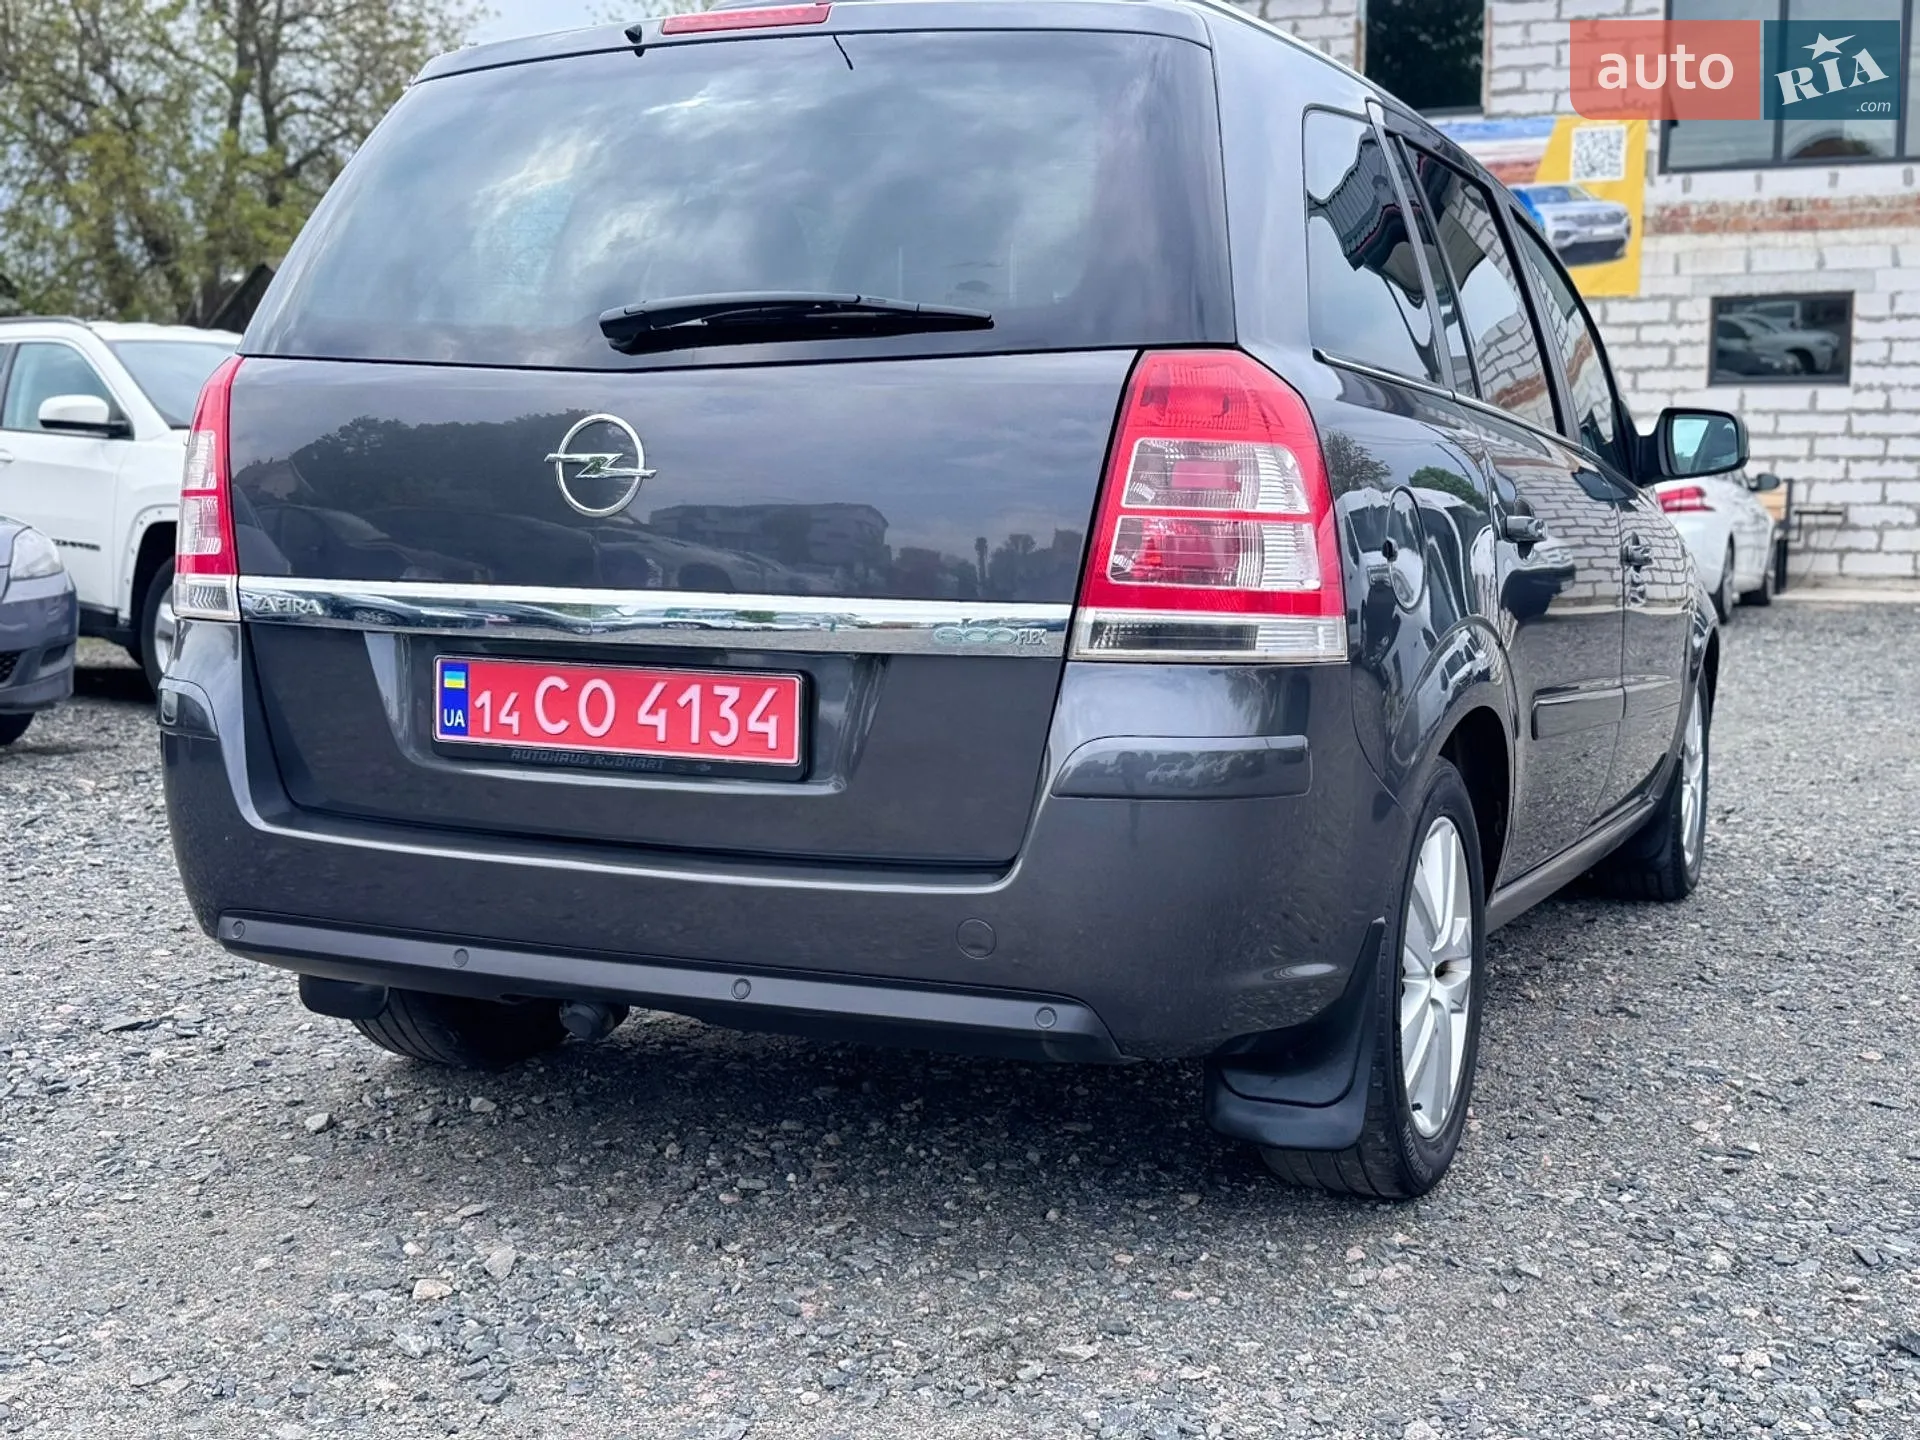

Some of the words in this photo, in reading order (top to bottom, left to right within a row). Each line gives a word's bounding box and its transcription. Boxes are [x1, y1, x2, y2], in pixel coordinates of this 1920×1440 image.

[444, 708, 465, 727] UA
[474, 690, 520, 735] 14
[534, 675, 616, 738] CO
[637, 681, 778, 750] 4134
[511, 749, 592, 766] AUTOHAUS
